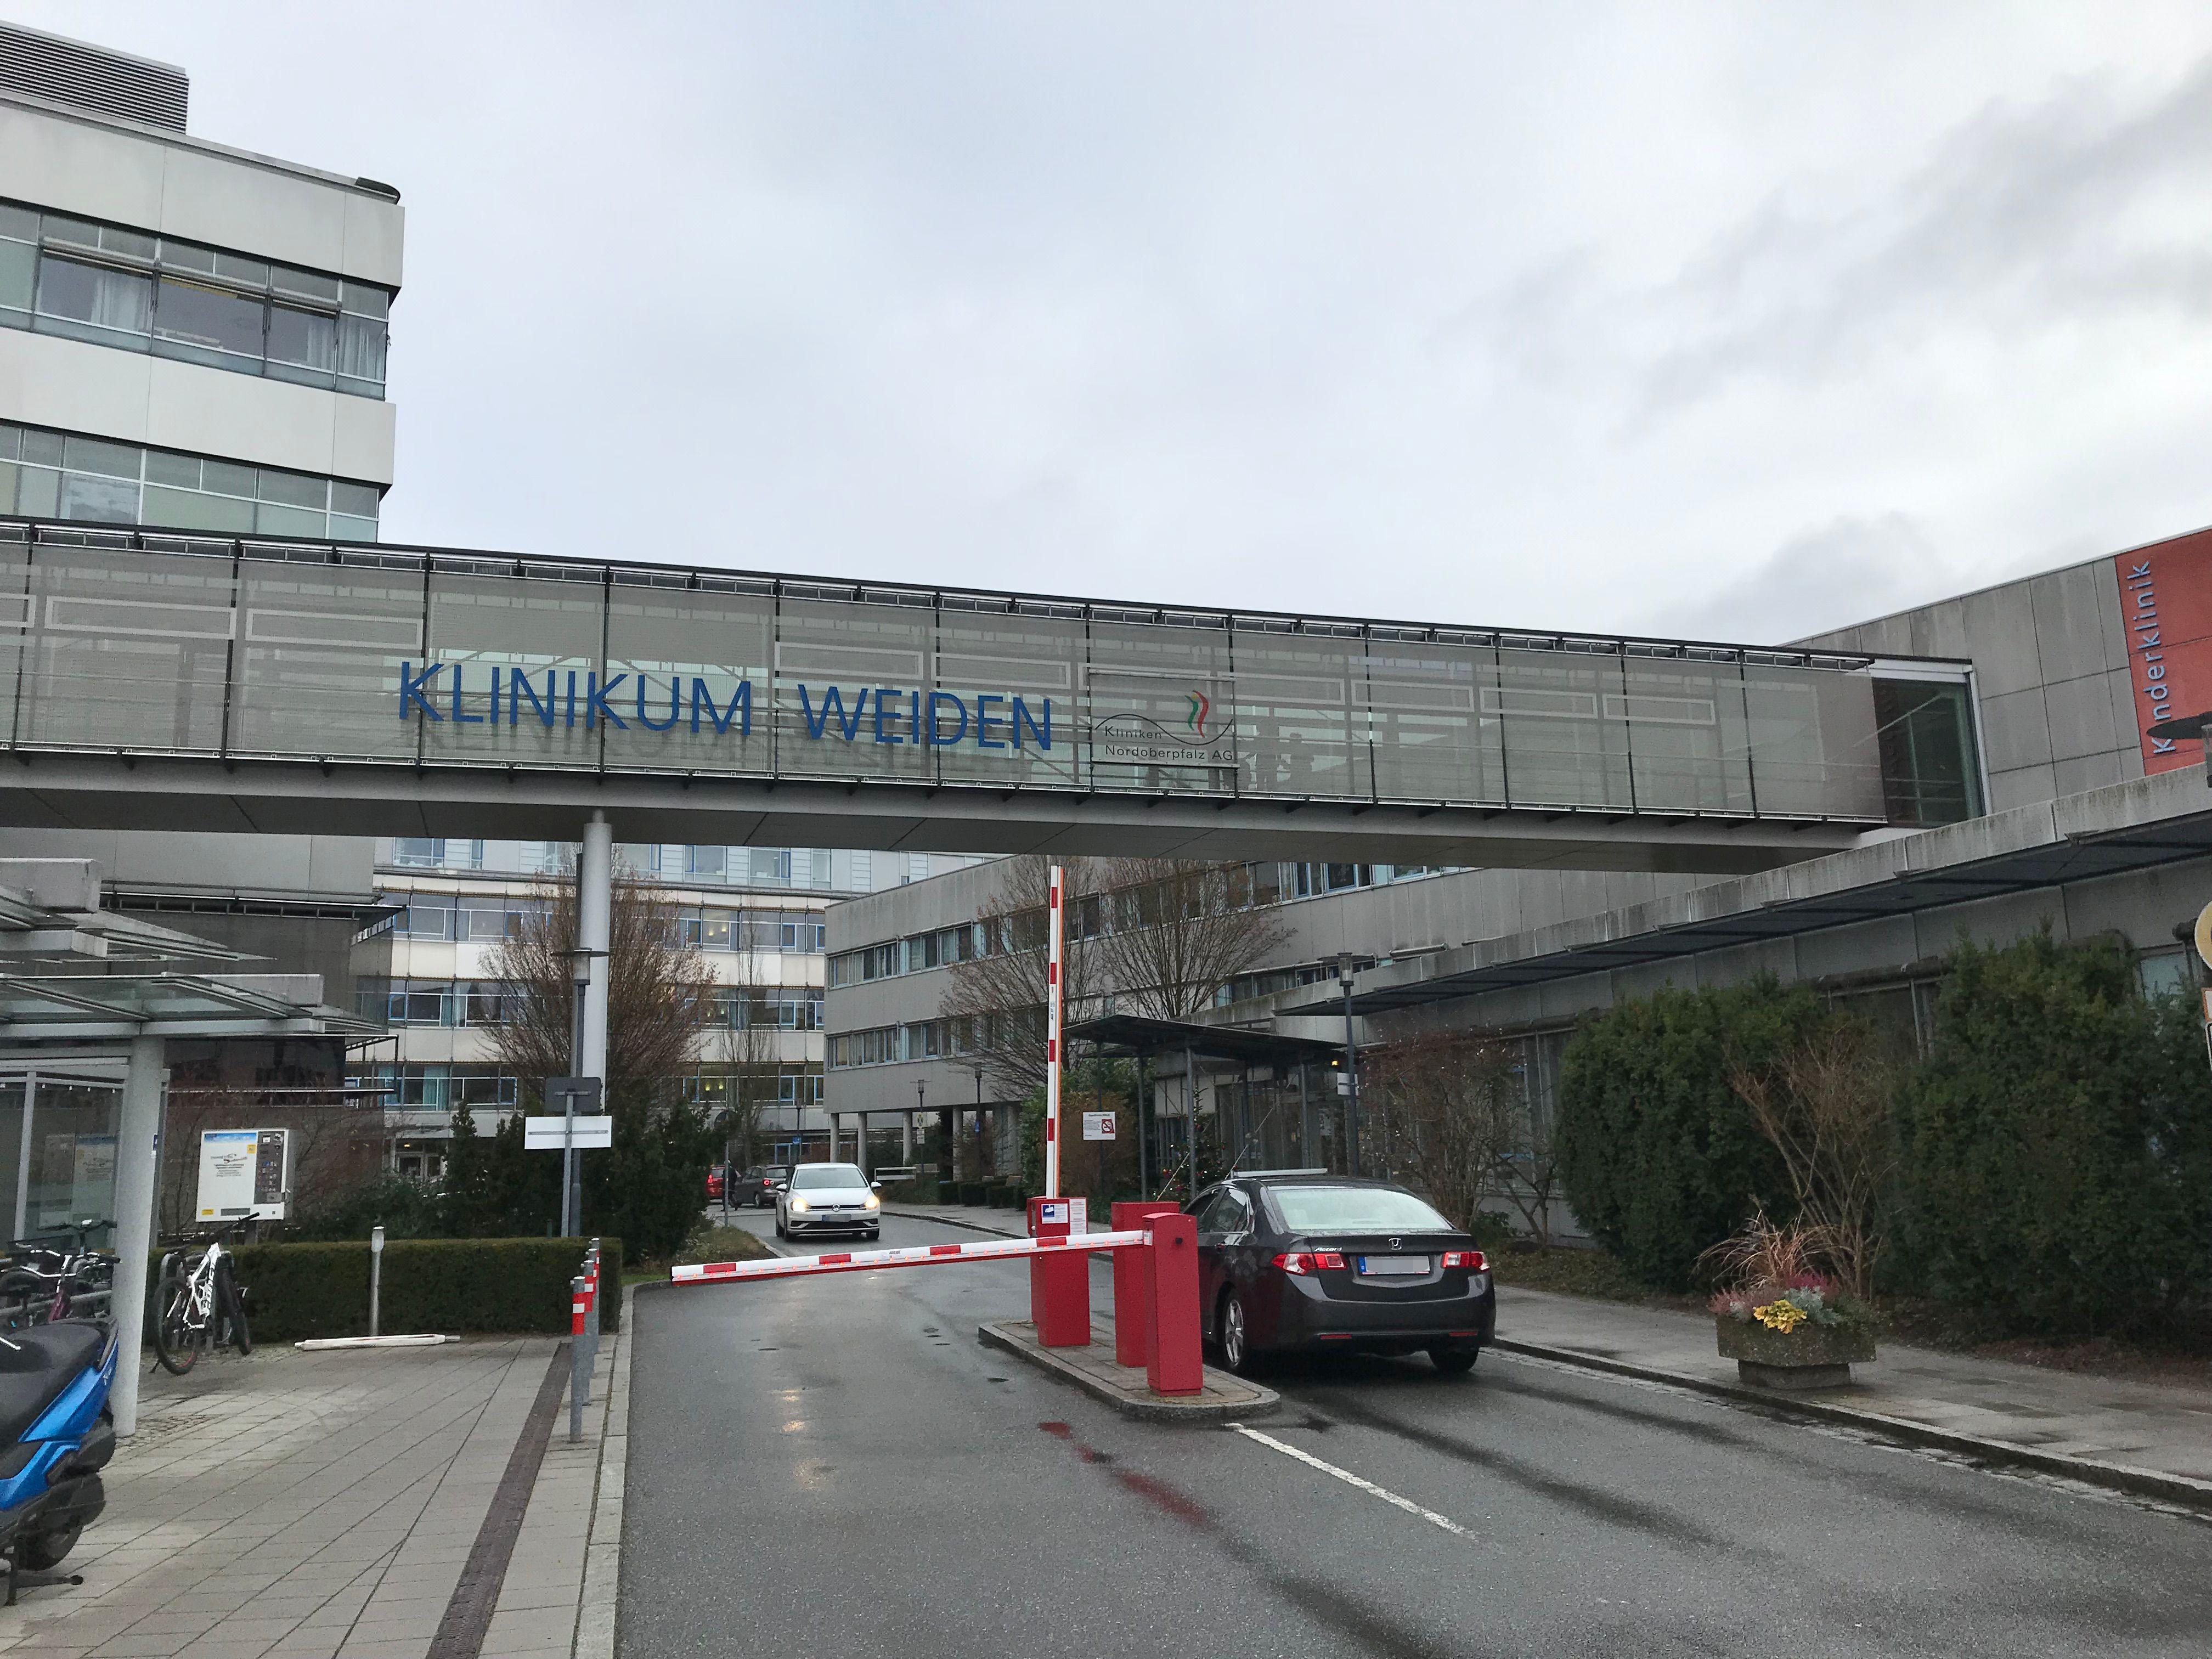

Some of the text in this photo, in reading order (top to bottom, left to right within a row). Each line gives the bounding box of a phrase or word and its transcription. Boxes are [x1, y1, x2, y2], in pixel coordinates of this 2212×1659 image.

[2126, 560, 2177, 755] Knderklinik
[399, 662, 1051, 750] KLINIKUM WEIDEN
[1105, 725, 1162, 740] Kliniken
[1105, 745, 1233, 761] Nordoberpfalz AG
